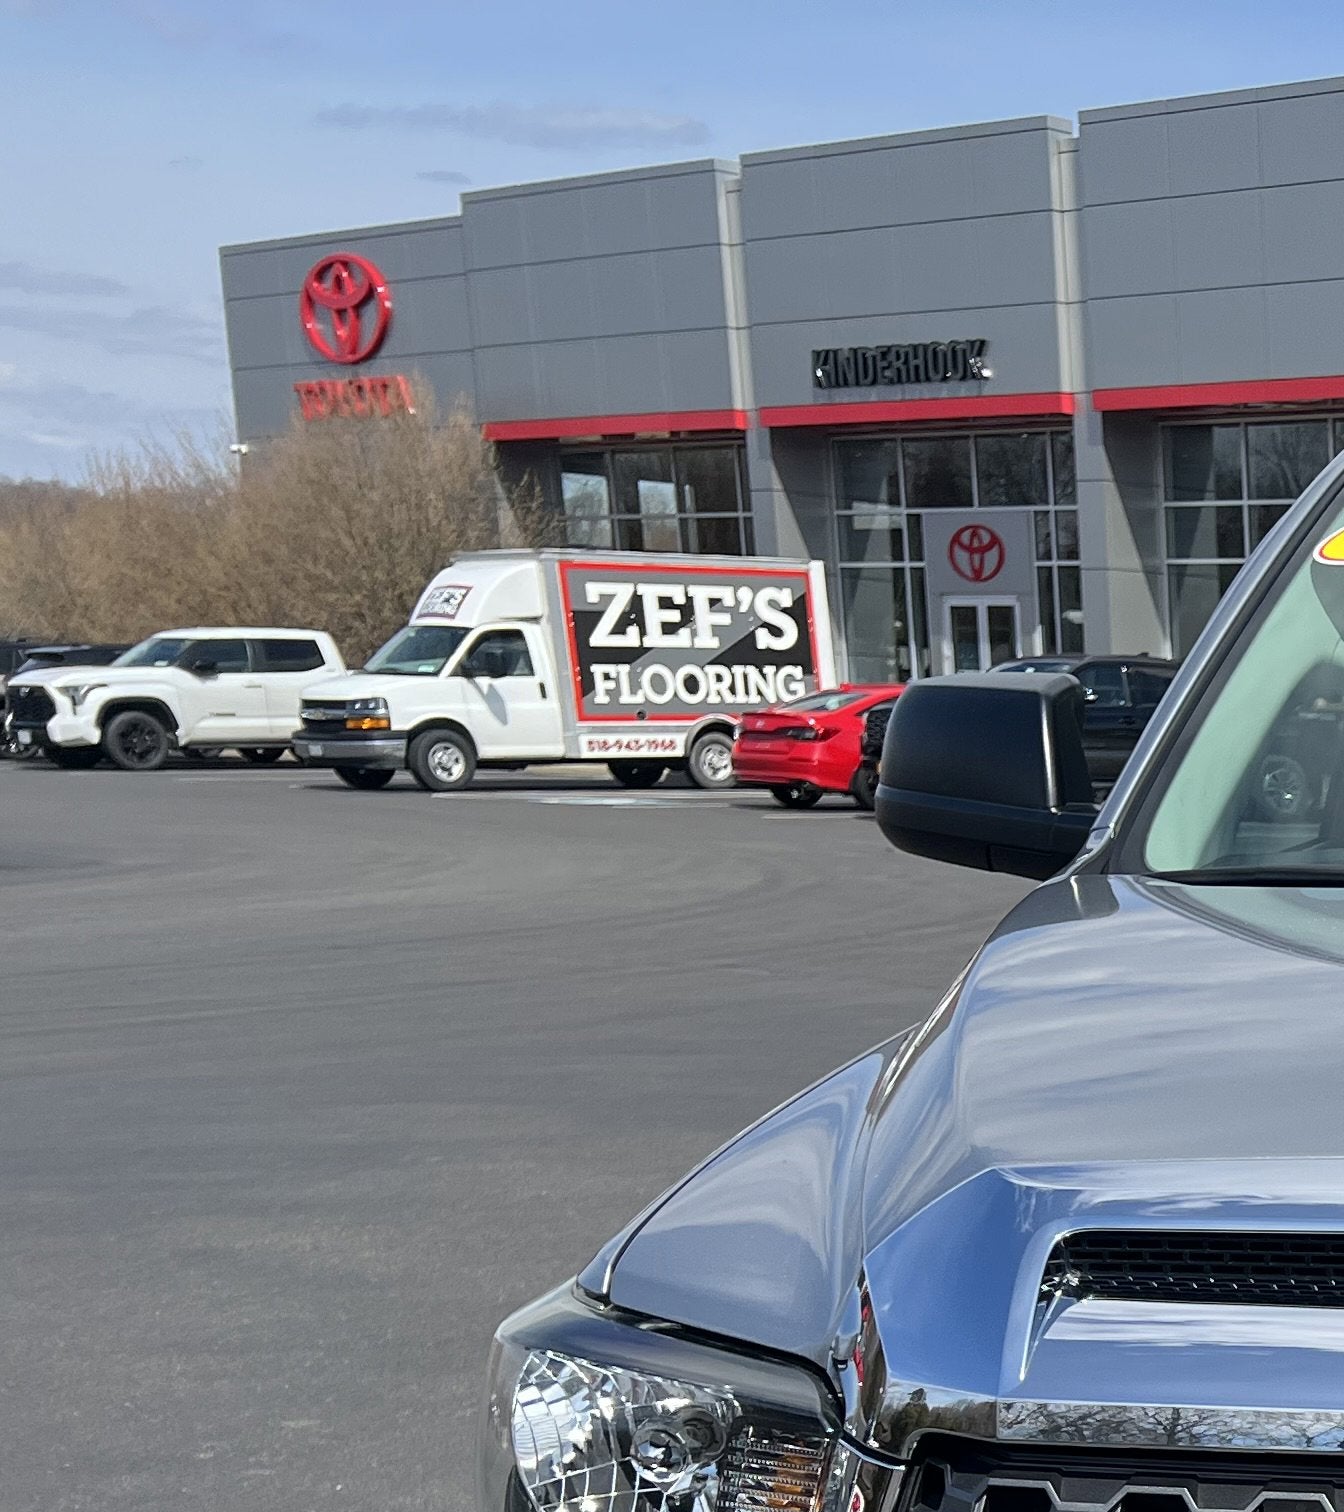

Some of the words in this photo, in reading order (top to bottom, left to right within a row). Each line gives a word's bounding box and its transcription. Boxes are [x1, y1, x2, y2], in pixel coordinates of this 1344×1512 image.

[810, 338, 988, 388] KINDERHOOK
[585, 581, 799, 651] ZEF'S
[590, 663, 806, 705] FLOORING
